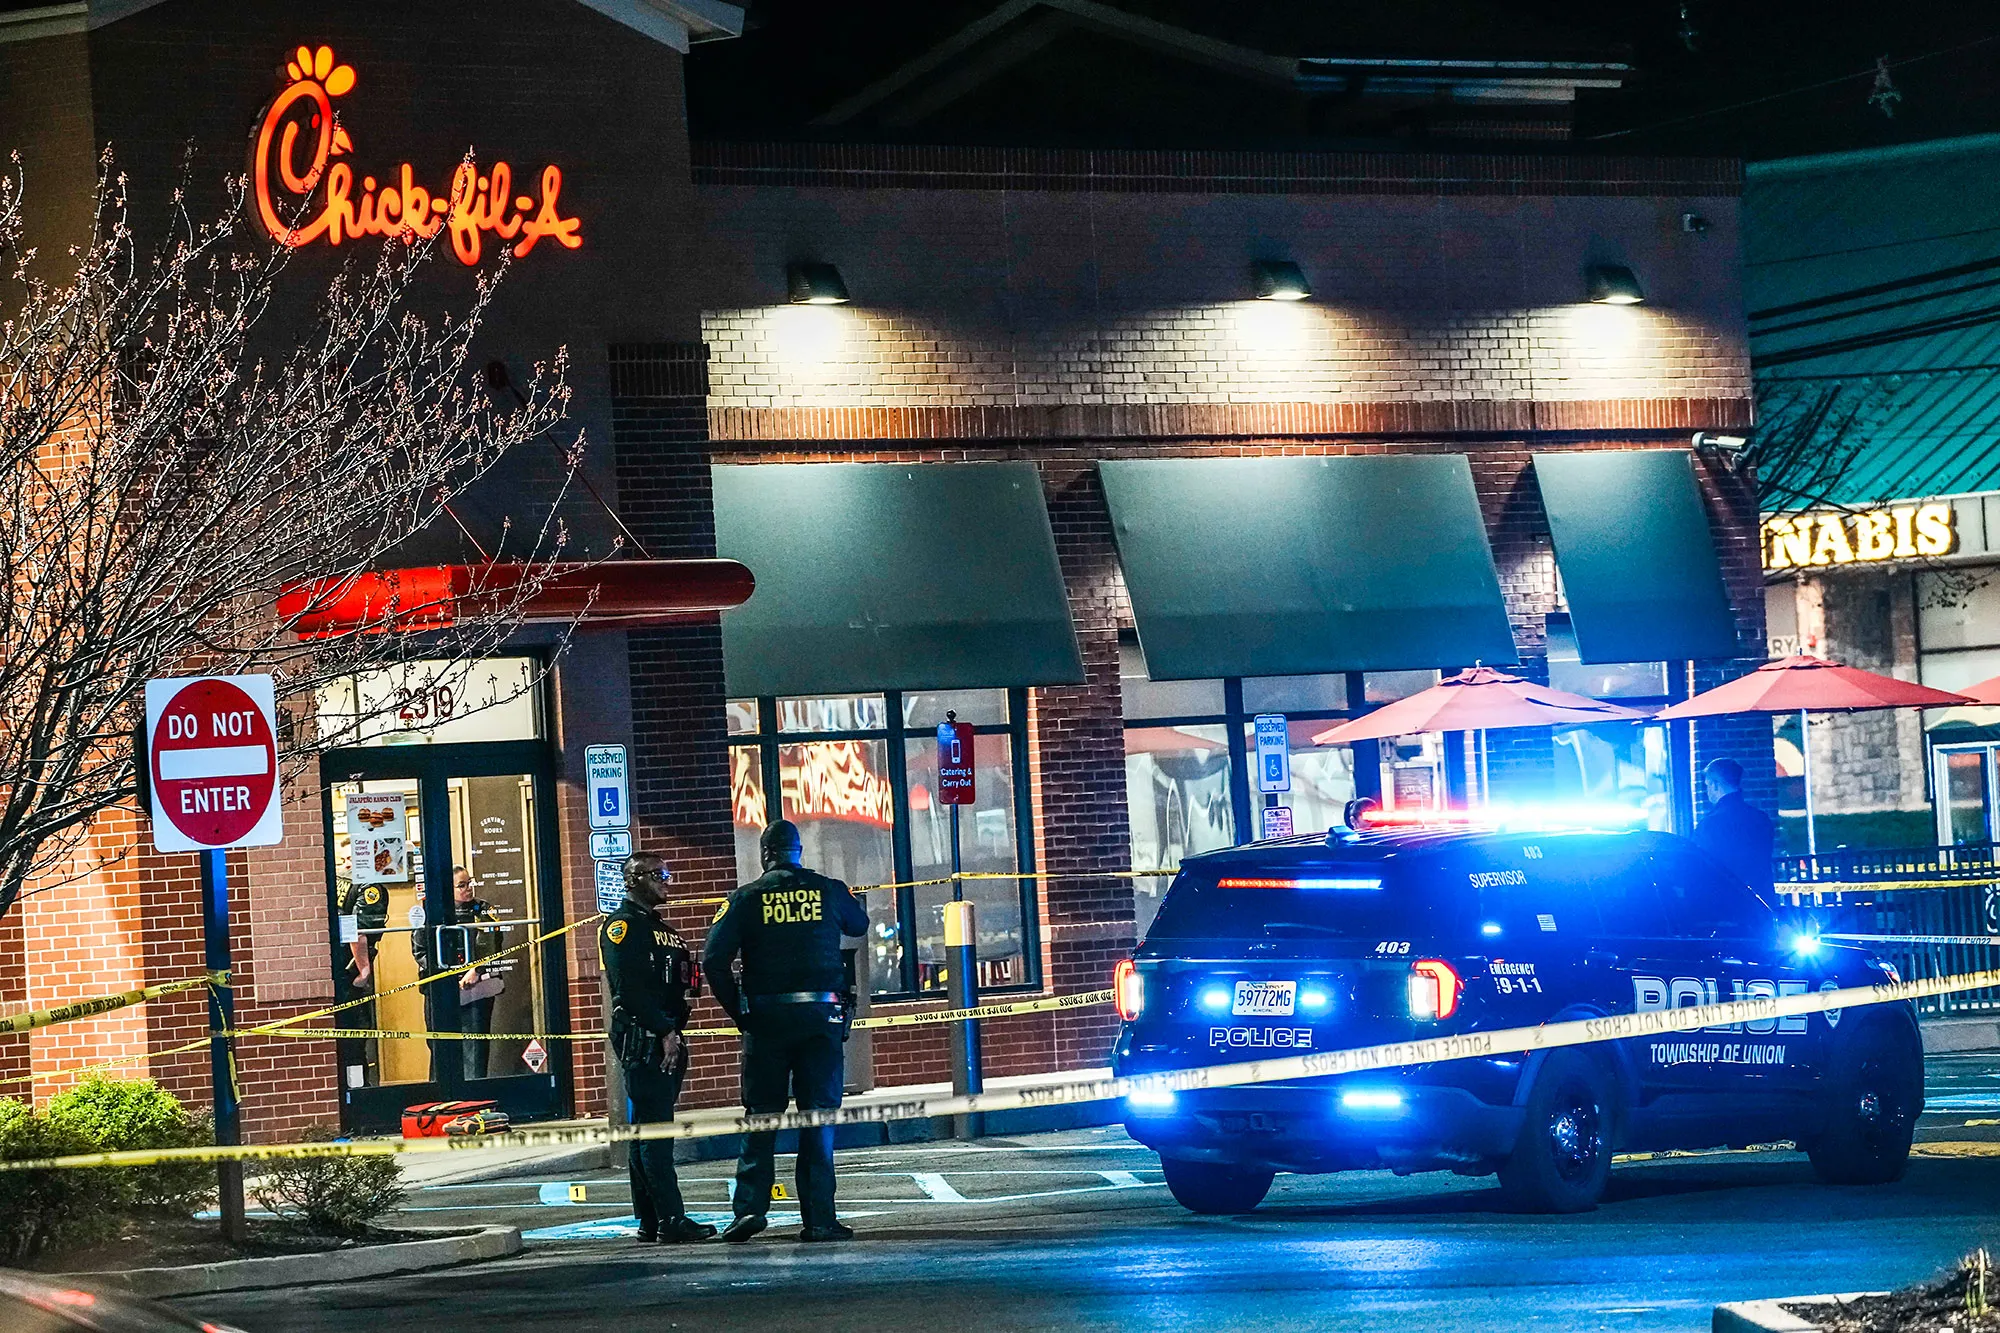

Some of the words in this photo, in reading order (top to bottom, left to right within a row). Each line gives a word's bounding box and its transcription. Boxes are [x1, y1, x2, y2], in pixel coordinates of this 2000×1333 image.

[255, 80, 584, 266] Chick-fil-A
[1760, 504, 1952, 568] NABIS
[398, 686, 454, 720] 2319
[168, 714, 198, 740] DO
[212, 711, 255, 737] NOT
[1257, 723, 1284, 733] RESERVED
[1260, 735, 1284, 745] PARKING
[589, 753, 623, 764] RESERVED
[592, 767, 622, 779] PARKING
[940, 768, 966, 777] Catering
[942, 780, 959, 788] Carry
[180, 786, 251, 814] ENTER
[480, 817, 505, 827] SERVING
[597, 845, 625, 853] ACCESSIBLE
[604, 837, 618, 845] VAN
[1523, 846, 1543, 859] 403
[1469, 870, 1527, 888] SUPERVISOR
[762, 889, 821, 905] UNION
[763, 902, 822, 924] POLICE
[653, 931, 683, 949] POLICE
[1374, 942, 1411, 954] 403
[1489, 963, 1535, 975] EMERGENCY
[1499, 977, 1543, 994] 9-1-1
[1872, 980, 1918, 1001] CROSS
[1927, 976, 1951, 994] NOT
[105, 996, 126, 1010] POLICE
[1238, 990, 1291, 1007] 59772MG
[1632, 976, 1808, 1035] POLICE
[1693, 1006, 1722, 1026] LINE
[1728, 1000, 1777, 1019] POLICE
[1586, 1018, 1631, 1038] CROSS
[1639, 1014, 1663, 1033] NOT
[1669, 1010, 1688, 1028] DO
[1209, 1027, 1313, 1047] POLICE
[1443, 1035, 1491, 1054] POLICE
[1354, 1050, 1378, 1070] NOT
[1385, 1046, 1403, 1065] DO
[1410, 1043, 1438, 1062] LINE
[1650, 1043, 1719, 1063] TOWNSHIP
[1723, 1044, 1740, 1062] OF
[1743, 1045, 1786, 1064] UNION
[1303, 1053, 1347, 1074] CROSS
[1019, 1085, 1064, 1105] CROSS
[574, 1188, 579, 1197] 1
[774, 1186, 782, 1196] 2
